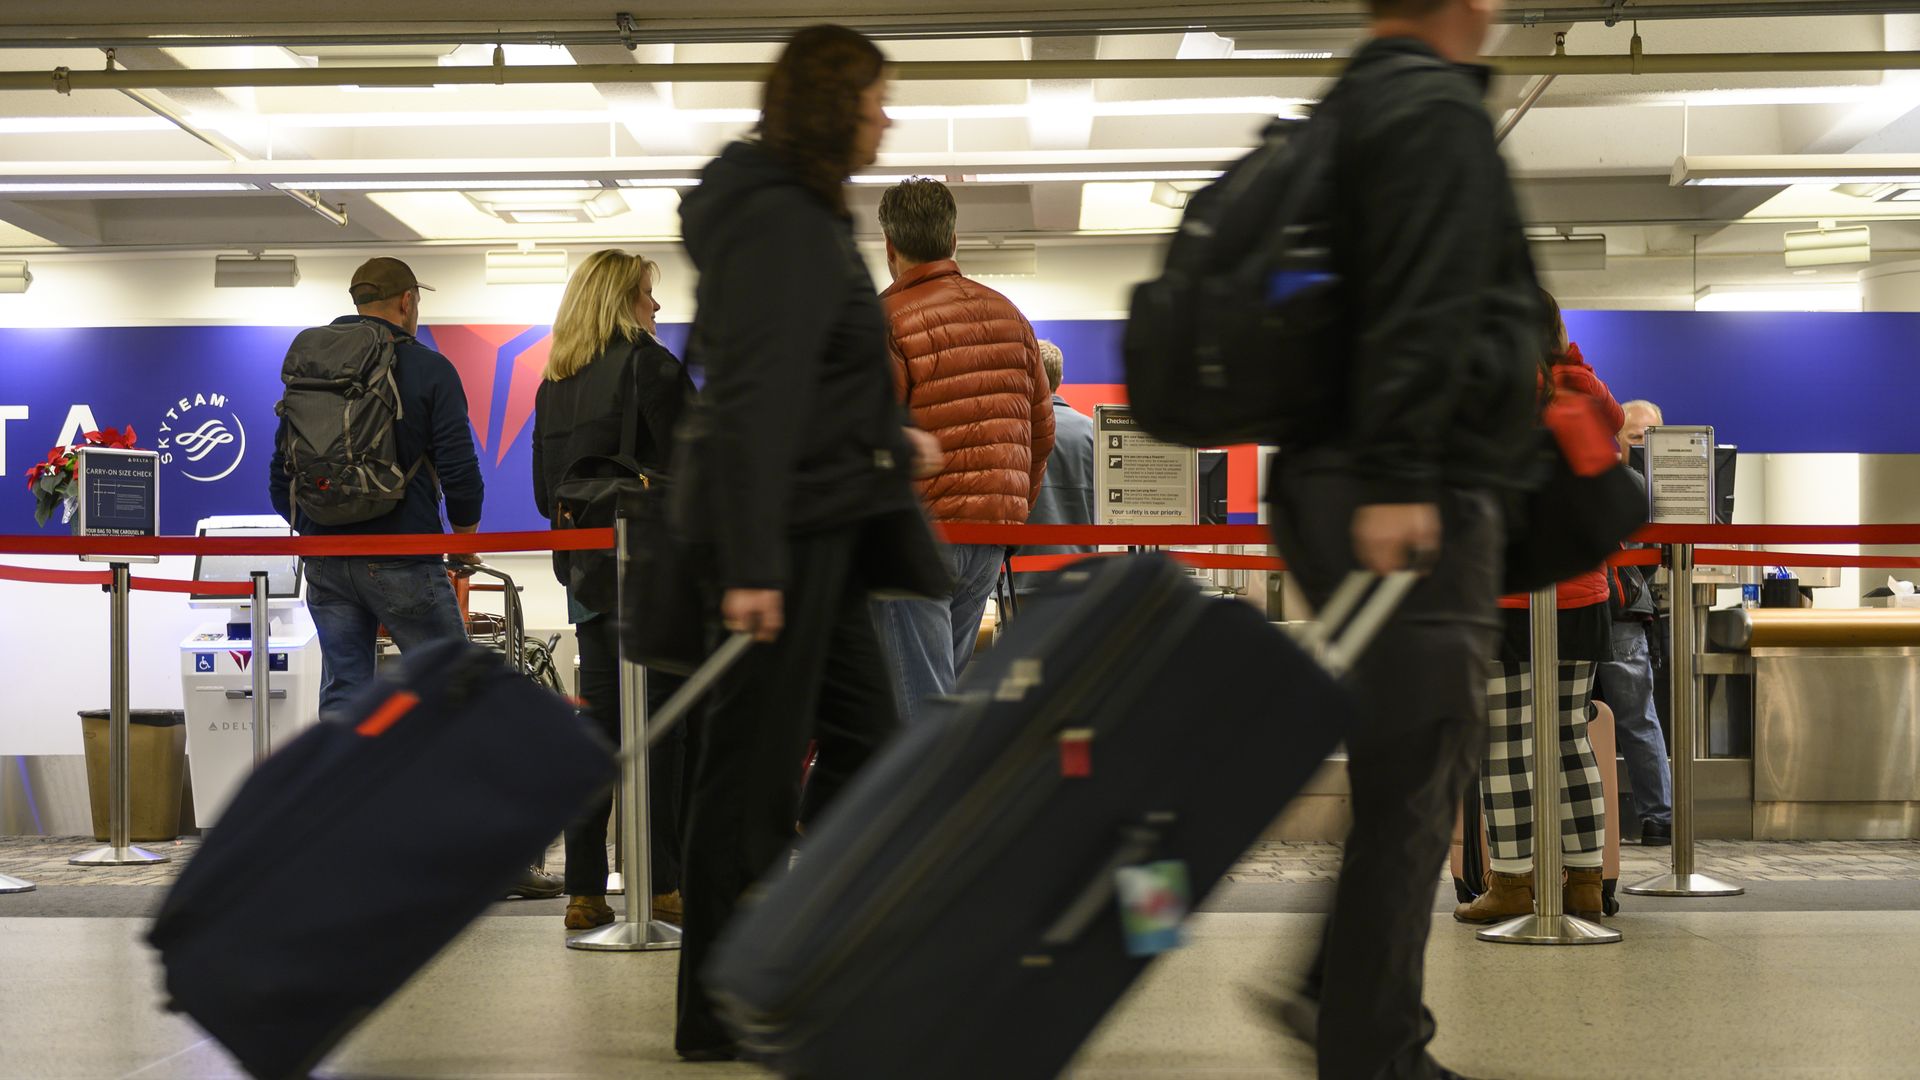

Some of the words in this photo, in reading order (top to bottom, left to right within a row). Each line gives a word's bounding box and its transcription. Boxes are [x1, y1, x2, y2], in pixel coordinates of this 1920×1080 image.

[159, 393, 225, 464] SKYTEAM
[86, 468, 118, 476] CARRY-ON
[119, 469, 132, 477] SIZE
[132, 470, 153, 478] CHECK
